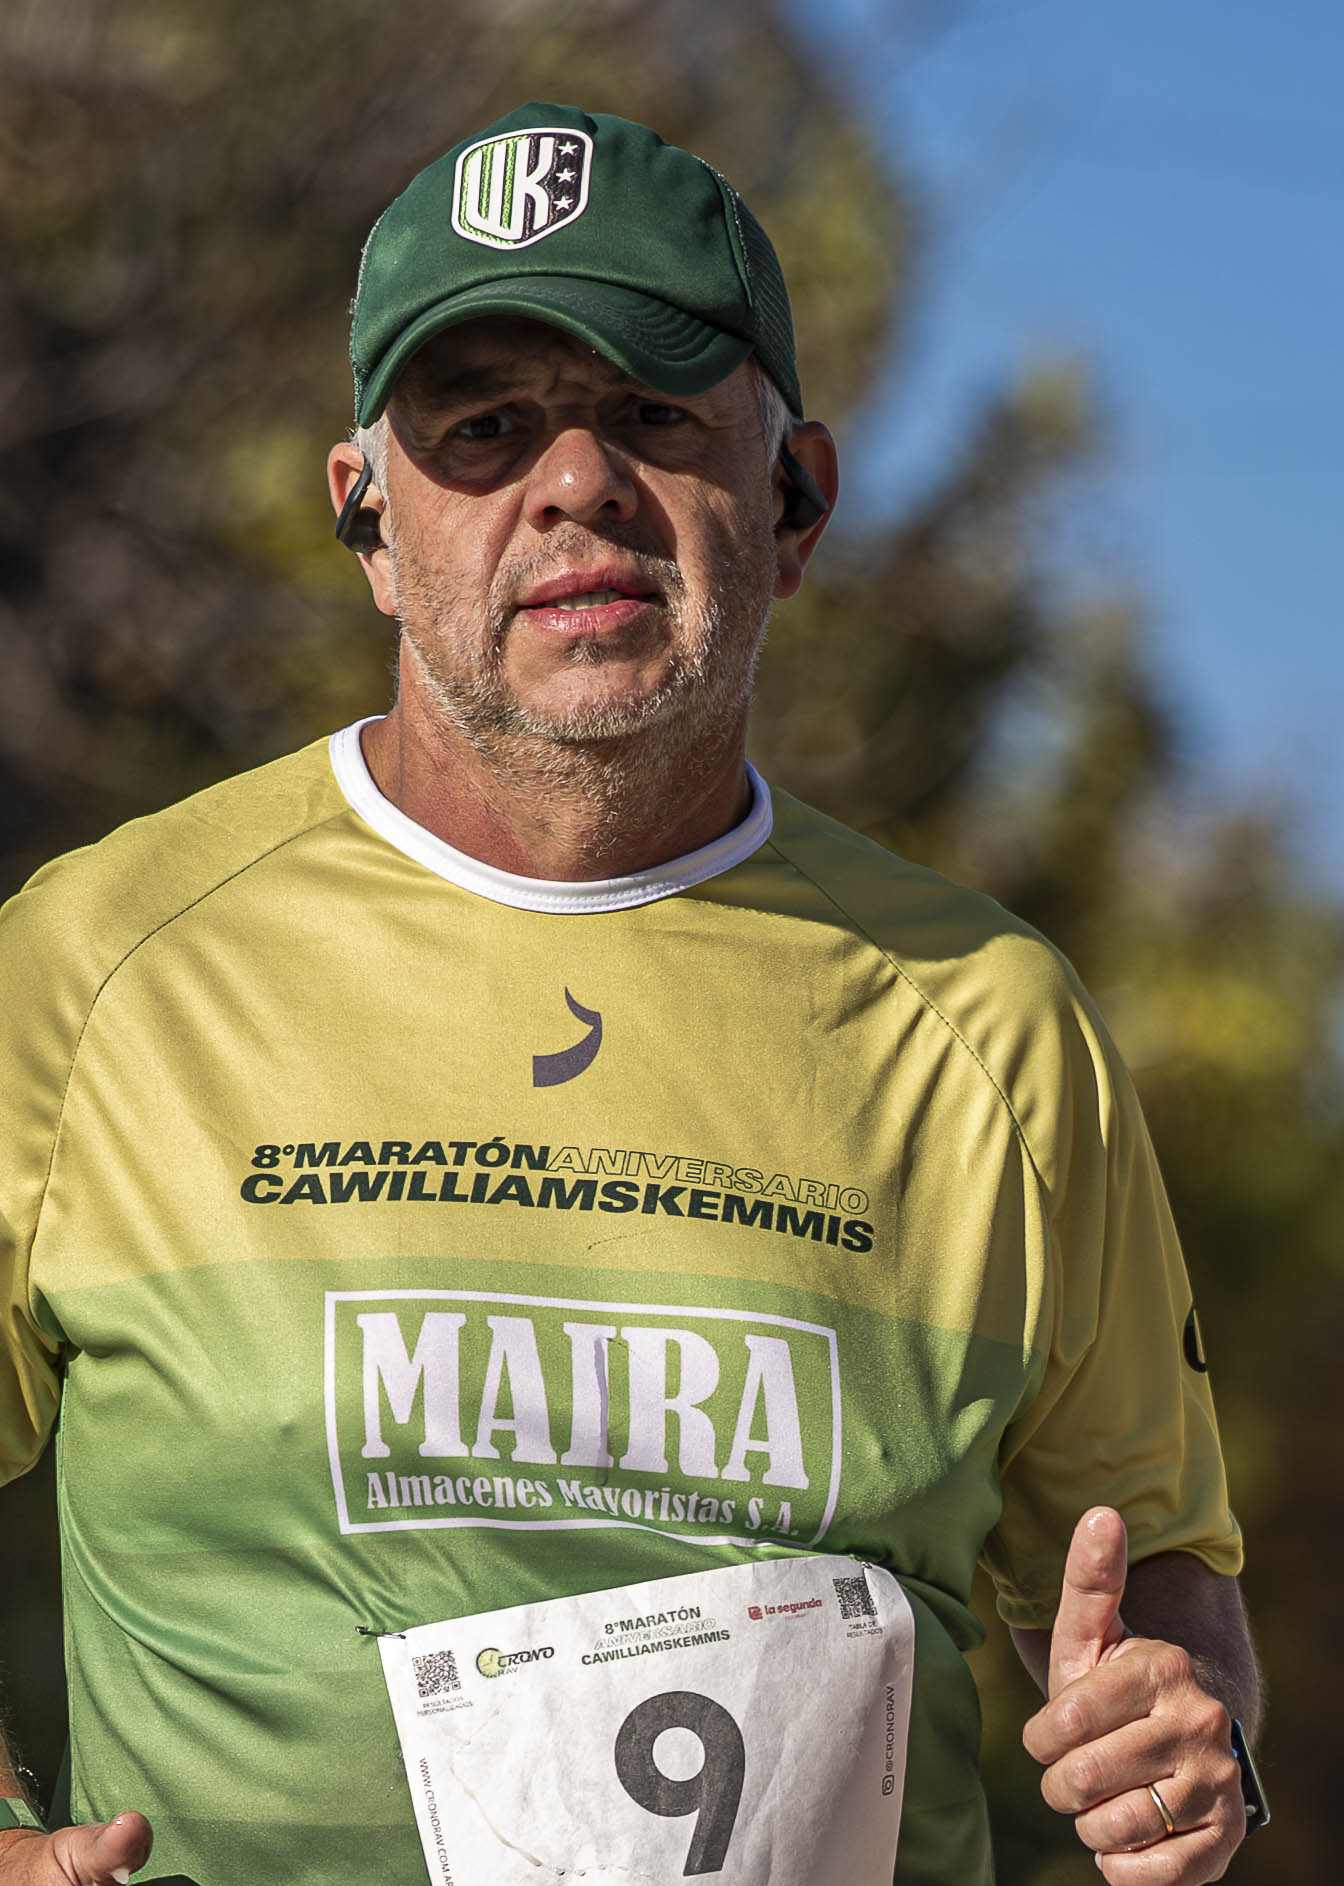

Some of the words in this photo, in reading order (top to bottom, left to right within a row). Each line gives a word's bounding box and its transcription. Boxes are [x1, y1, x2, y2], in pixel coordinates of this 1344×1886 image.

[239, 1172, 876, 1254] CAWILLIAMSKEMMIS
[356, 1311, 810, 1491] MAIRA
[366, 1472, 554, 1511] Almacenes
[558, 1479, 737, 1525] Mayoristas
[744, 1499, 801, 1537] S.A.
[581, 1629, 731, 1666] CAWILLIAMSKEMMIS
[764, 1604, 776, 1616] la
[777, 1597, 823, 1615] segunda
[885, 1686, 895, 1772] @CRONORAV
[614, 1690, 746, 1877] 9
